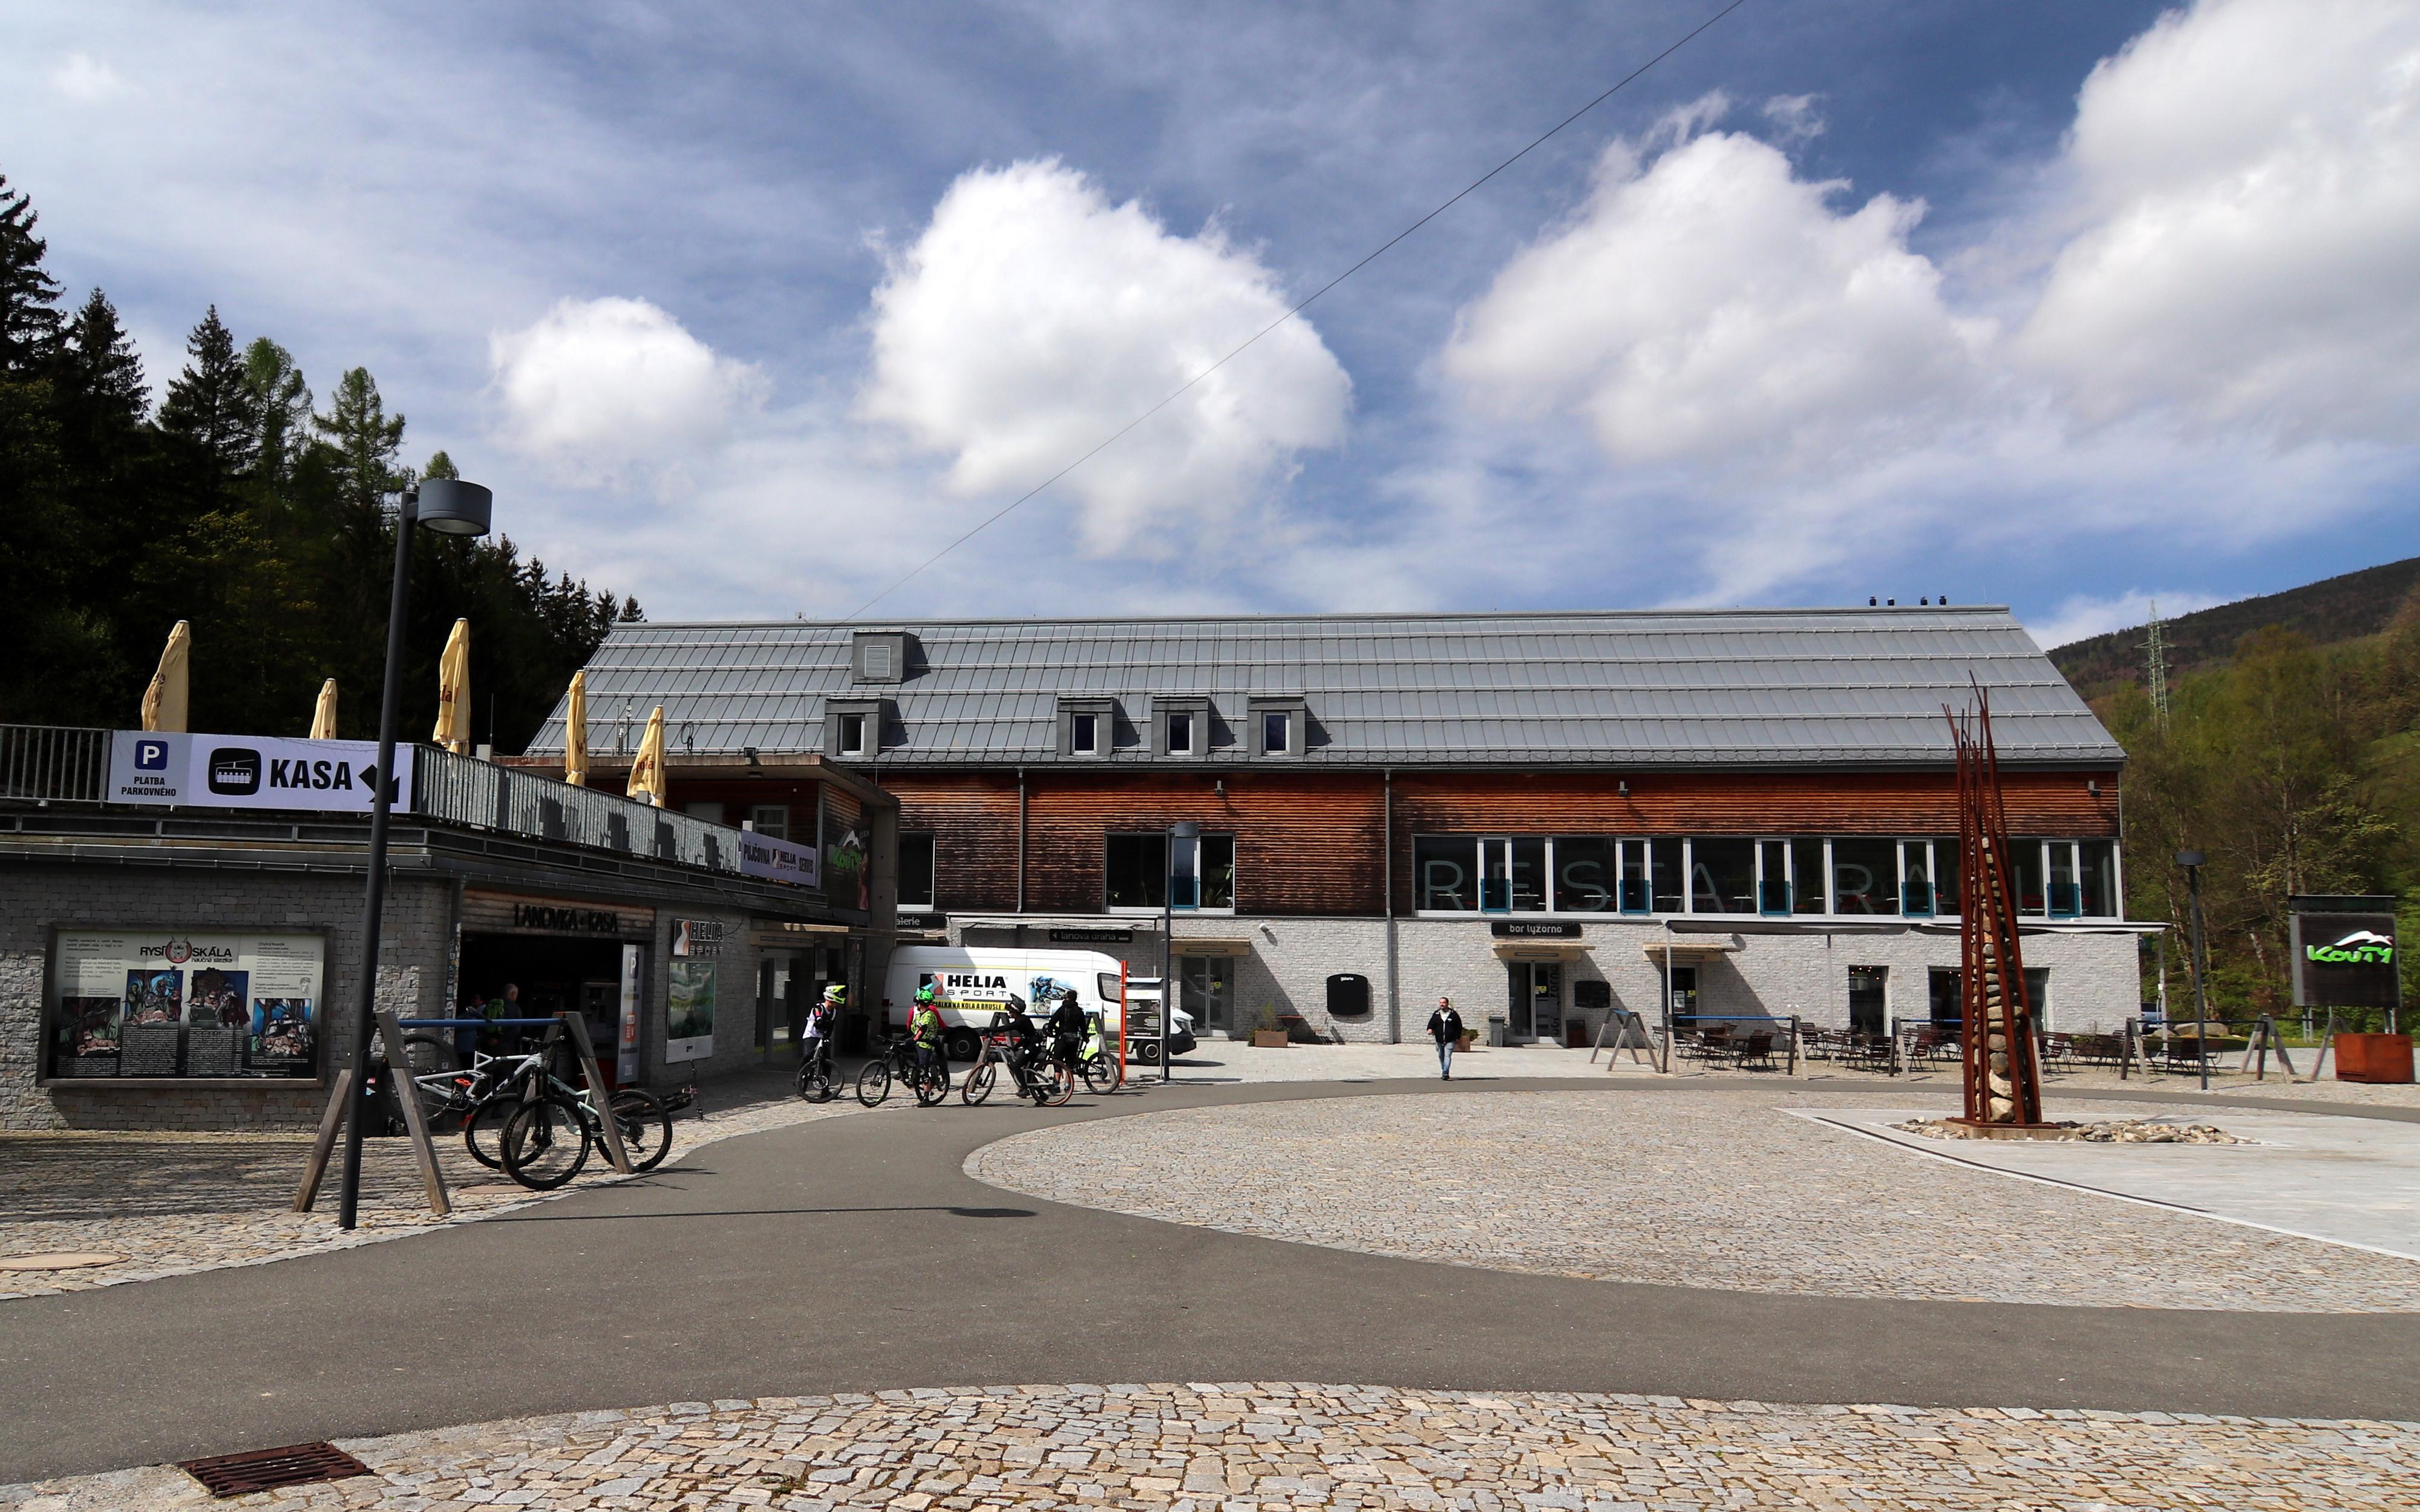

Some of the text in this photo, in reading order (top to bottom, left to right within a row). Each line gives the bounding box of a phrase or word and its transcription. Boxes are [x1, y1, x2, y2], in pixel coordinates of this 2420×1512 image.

[143, 745, 160, 765] P
[134, 776, 165, 785] PLATBA
[270, 759, 353, 790] KASA
[121, 787, 177, 797] PARKOVNÉHO
[780, 851, 796, 865] HELIA
[1425, 860, 2093, 915] RESTAURAT
[515, 904, 578, 930] LANOVKA
[896, 917, 920, 925] alerie
[690, 920, 724, 941] HELIA
[192, 946, 232, 957] SKÁLA
[690, 946, 723, 957] SPORT
[947, 975, 1006, 989] HELIA
